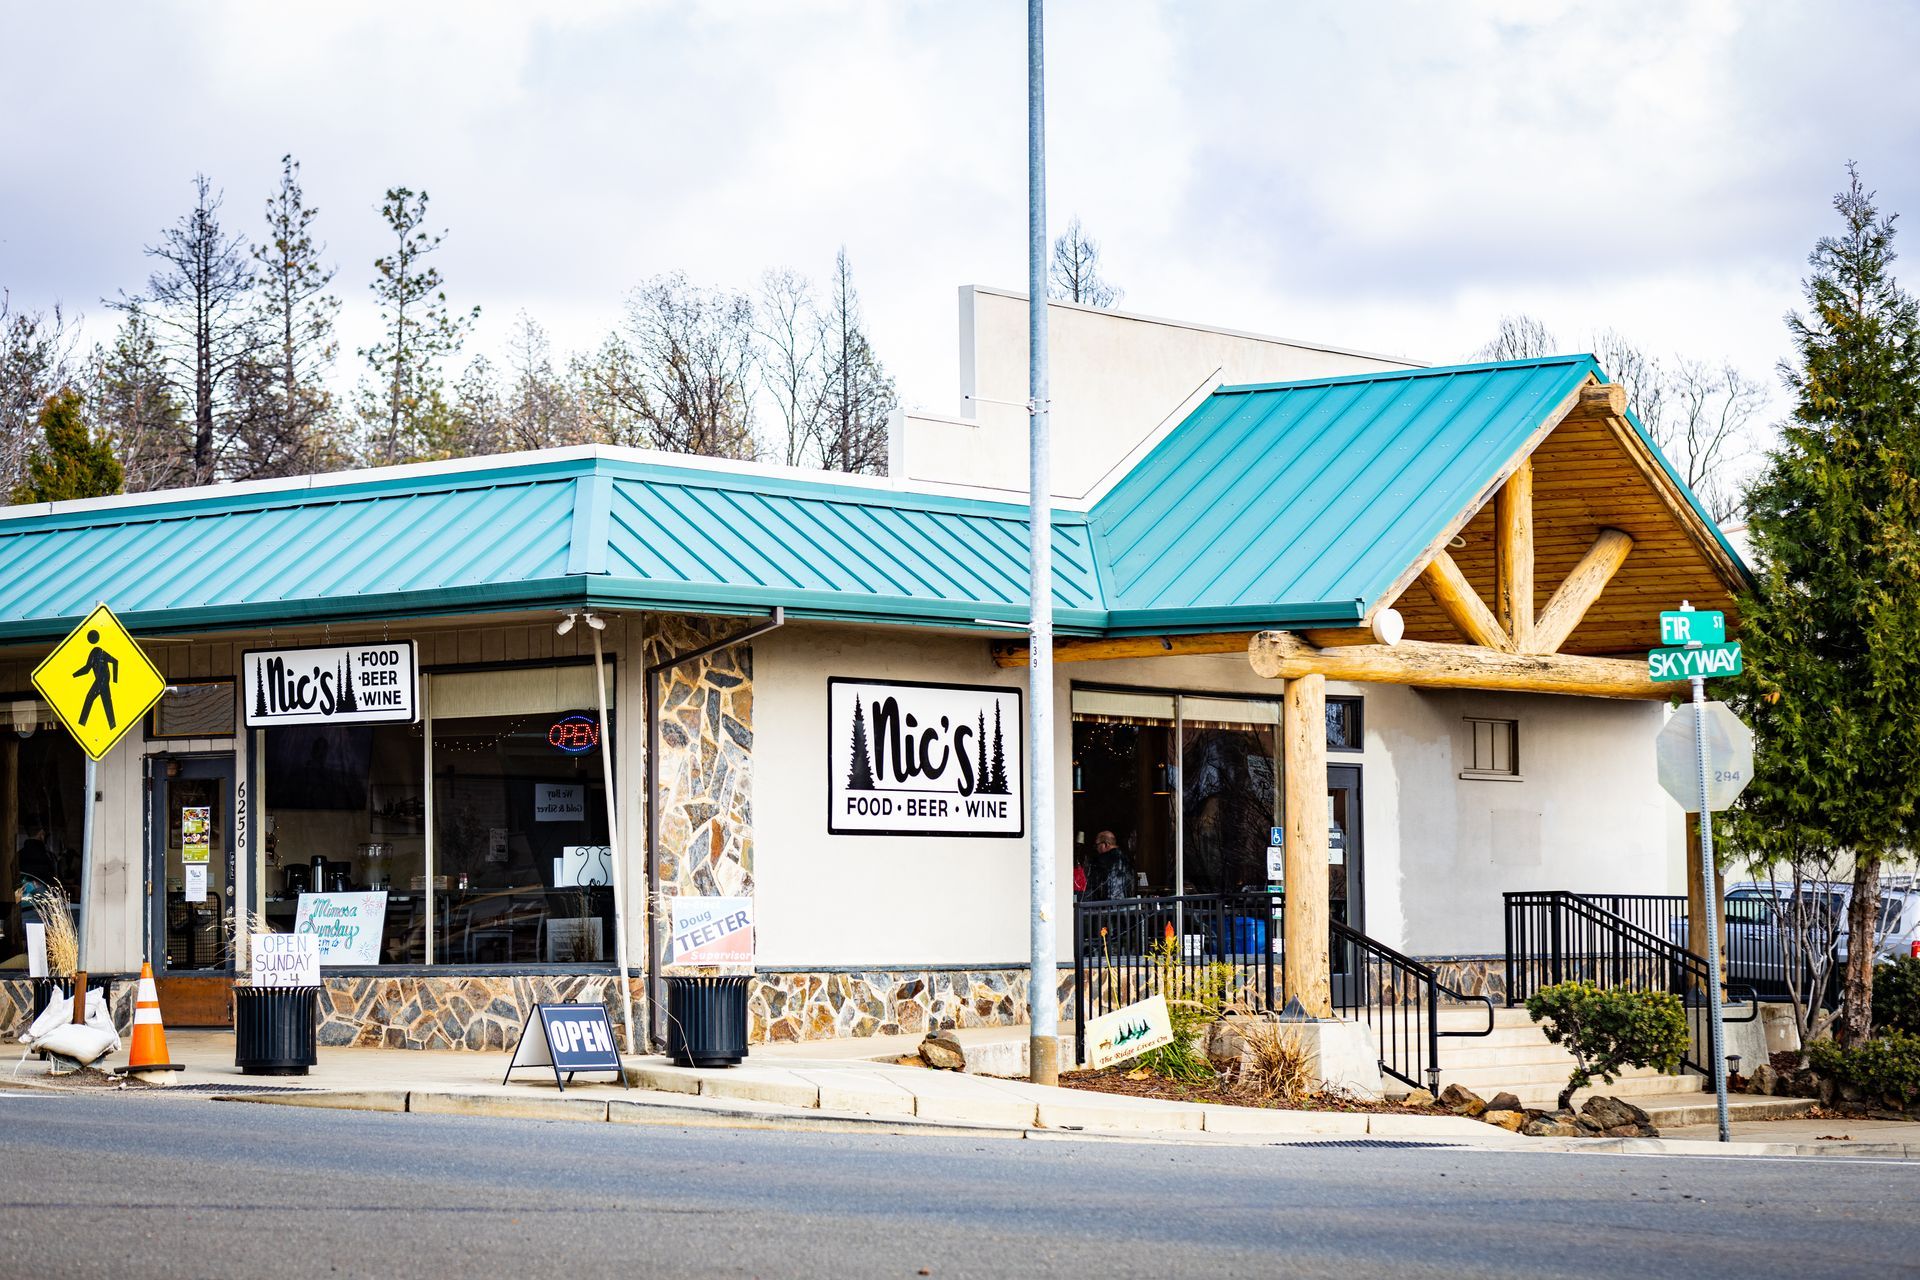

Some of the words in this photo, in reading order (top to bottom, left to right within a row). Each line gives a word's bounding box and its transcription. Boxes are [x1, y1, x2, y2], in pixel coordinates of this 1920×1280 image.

[1662, 616, 1691, 640] FIR
[1712, 615, 1723, 629] ST
[361, 650, 399, 667] FOOD
[1648, 647, 1740, 677] SKYWAY
[266, 656, 336, 716] Nic's
[361, 670, 398, 687] BEER
[362, 690, 402, 706] WINE
[549, 723, 599, 746] OPEN
[872, 696, 975, 797] Nic's
[1714, 770, 1740, 782] 294
[237, 781, 246, 848] 6256
[846, 797, 893, 816] FOOD
[907, 798, 948, 817] BEER
[965, 800, 1008, 819] WINE
[310, 898, 358, 918] Mimosa
[680, 910, 712, 929] Doug
[299, 915, 359, 950] Sunday
[675, 910, 750, 952] TEETER
[263, 935, 307, 953] OPEN
[255, 953, 313, 972] SUNDAY
[690, 950, 751, 962] Supervisor
[550, 1020, 612, 1053] OPEN
[1100, 1056, 1113, 1064] The
[1114, 1048, 1135, 1059] Ridge
